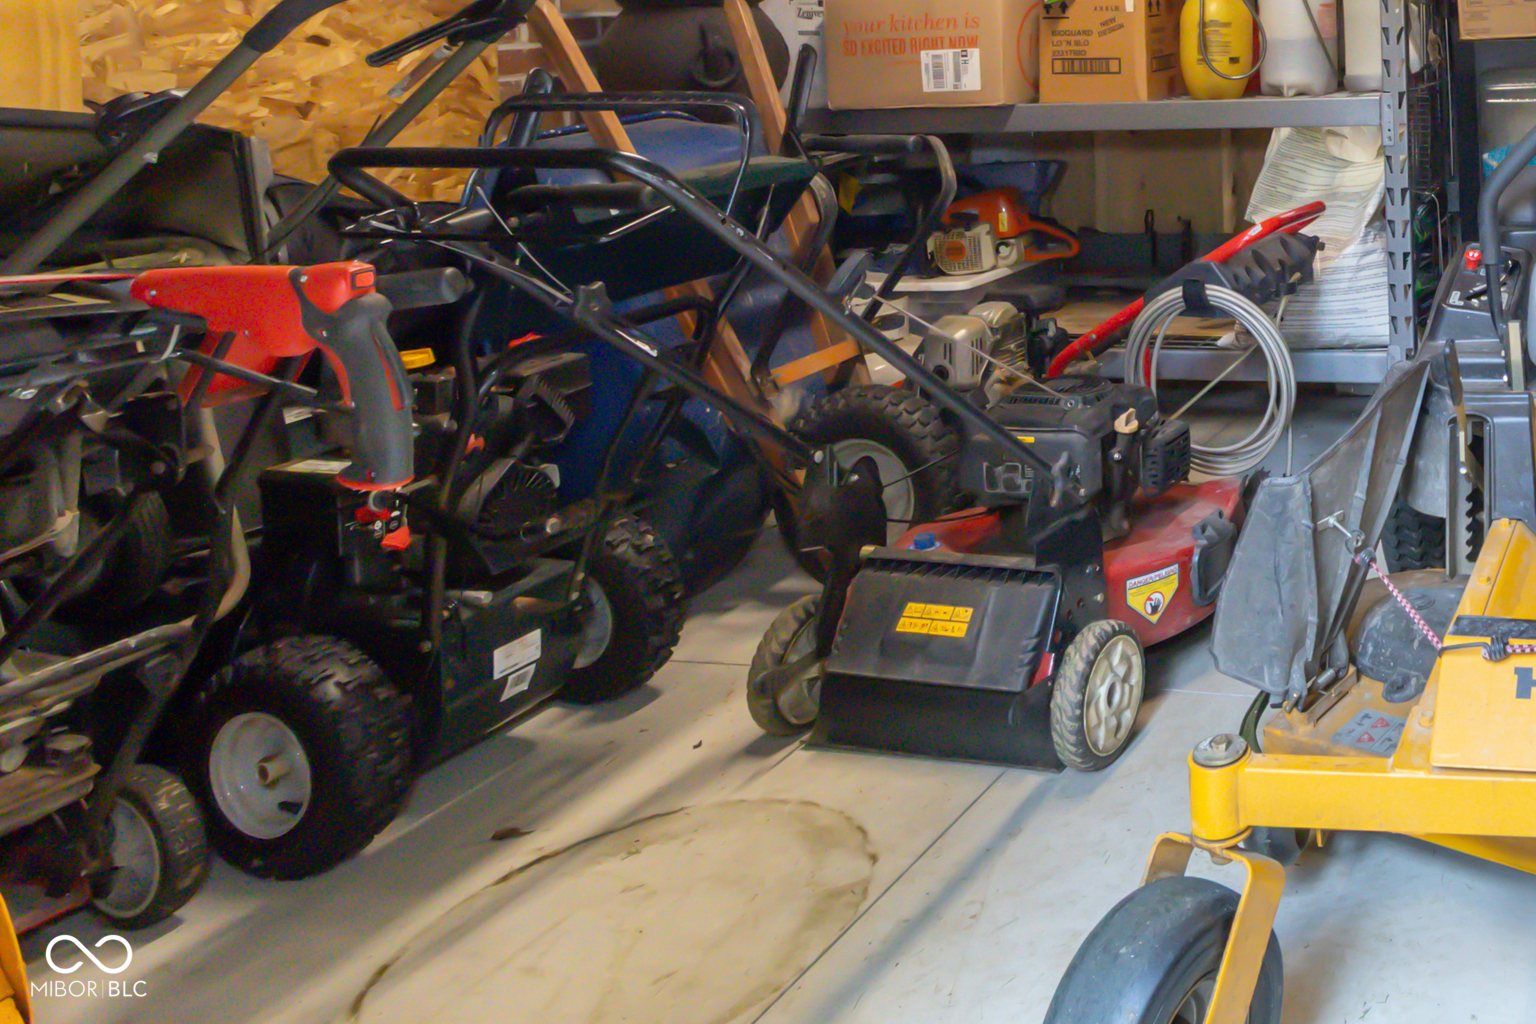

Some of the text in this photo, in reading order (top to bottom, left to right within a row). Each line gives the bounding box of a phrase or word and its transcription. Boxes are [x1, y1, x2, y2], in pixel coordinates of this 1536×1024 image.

[797, 7, 824, 20] Zenive
[842, 12, 980, 36] your kitchen is
[1100, 17, 1117, 27] NEW
[1052, 29, 1093, 37] BIOGUARD
[1097, 23, 1125, 37] DESIGN
[842, 35, 978, 57] SO EXCITED RIGHT NOW
[1074, 39, 1090, 47] SLO
